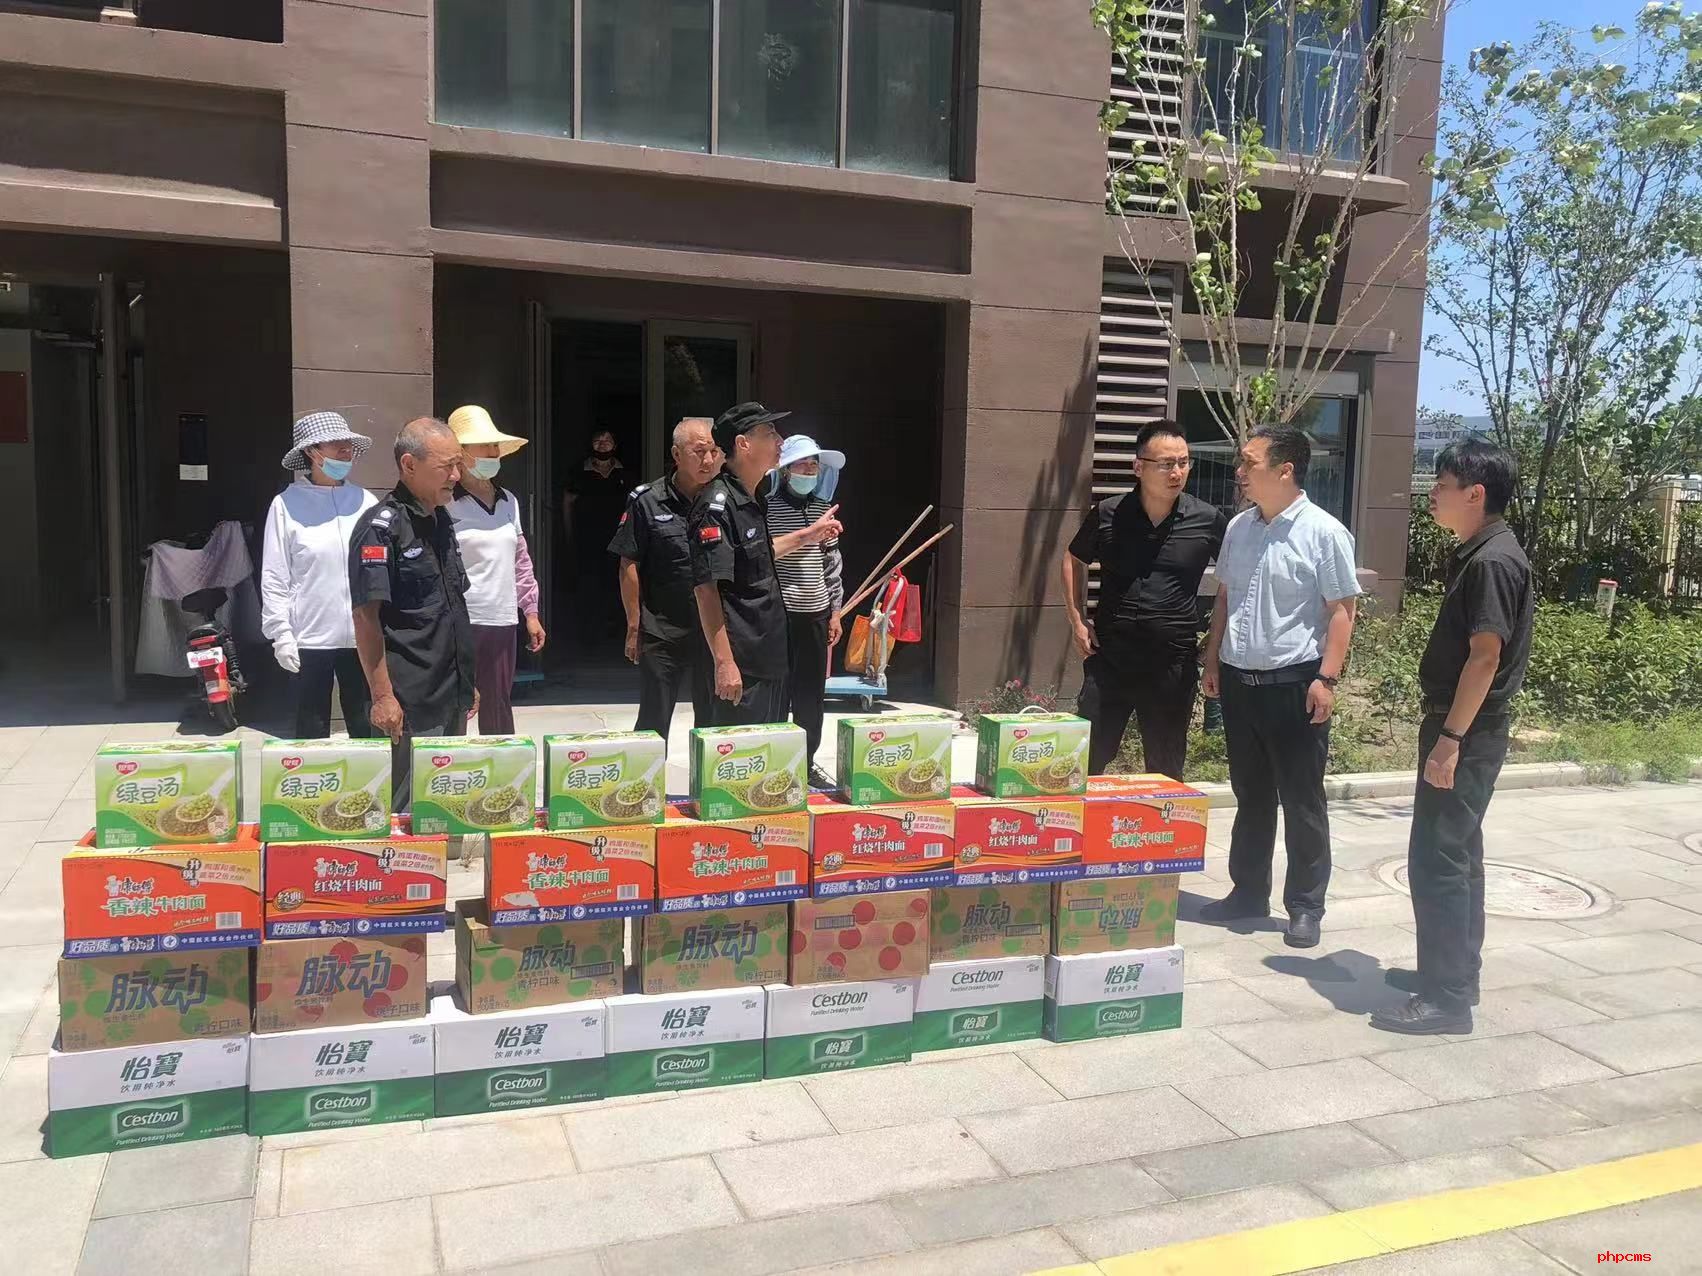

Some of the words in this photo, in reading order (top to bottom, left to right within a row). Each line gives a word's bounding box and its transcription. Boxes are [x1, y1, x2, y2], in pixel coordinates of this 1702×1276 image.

[868, 744, 914, 767] 绿豆汤
[1012, 741, 1056, 764] 绿豆汤
[567, 763, 621, 789] 绿豆汤
[717, 755, 766, 780] 绿豆汤
[116, 776, 180, 805] 绿豆汤
[280, 772, 340, 799] 绿豆汤
[432, 770, 487, 796] 绿豆汤
[852, 840, 905, 855] 红烧牛肉面
[522, 869, 610, 890] 香辣牛肉面
[688, 855, 768, 878] 香辣牛肉面
[314, 878, 382, 893] 红烧牛肉面
[101, 894, 206, 917] 香辣牛肉面
[963, 901, 1011, 930] 脉动
[519, 940, 576, 972] 脉动
[677, 920, 759, 966] 脉动
[296, 950, 391, 999] 脉动
[104, 964, 209, 1015] 脉动
